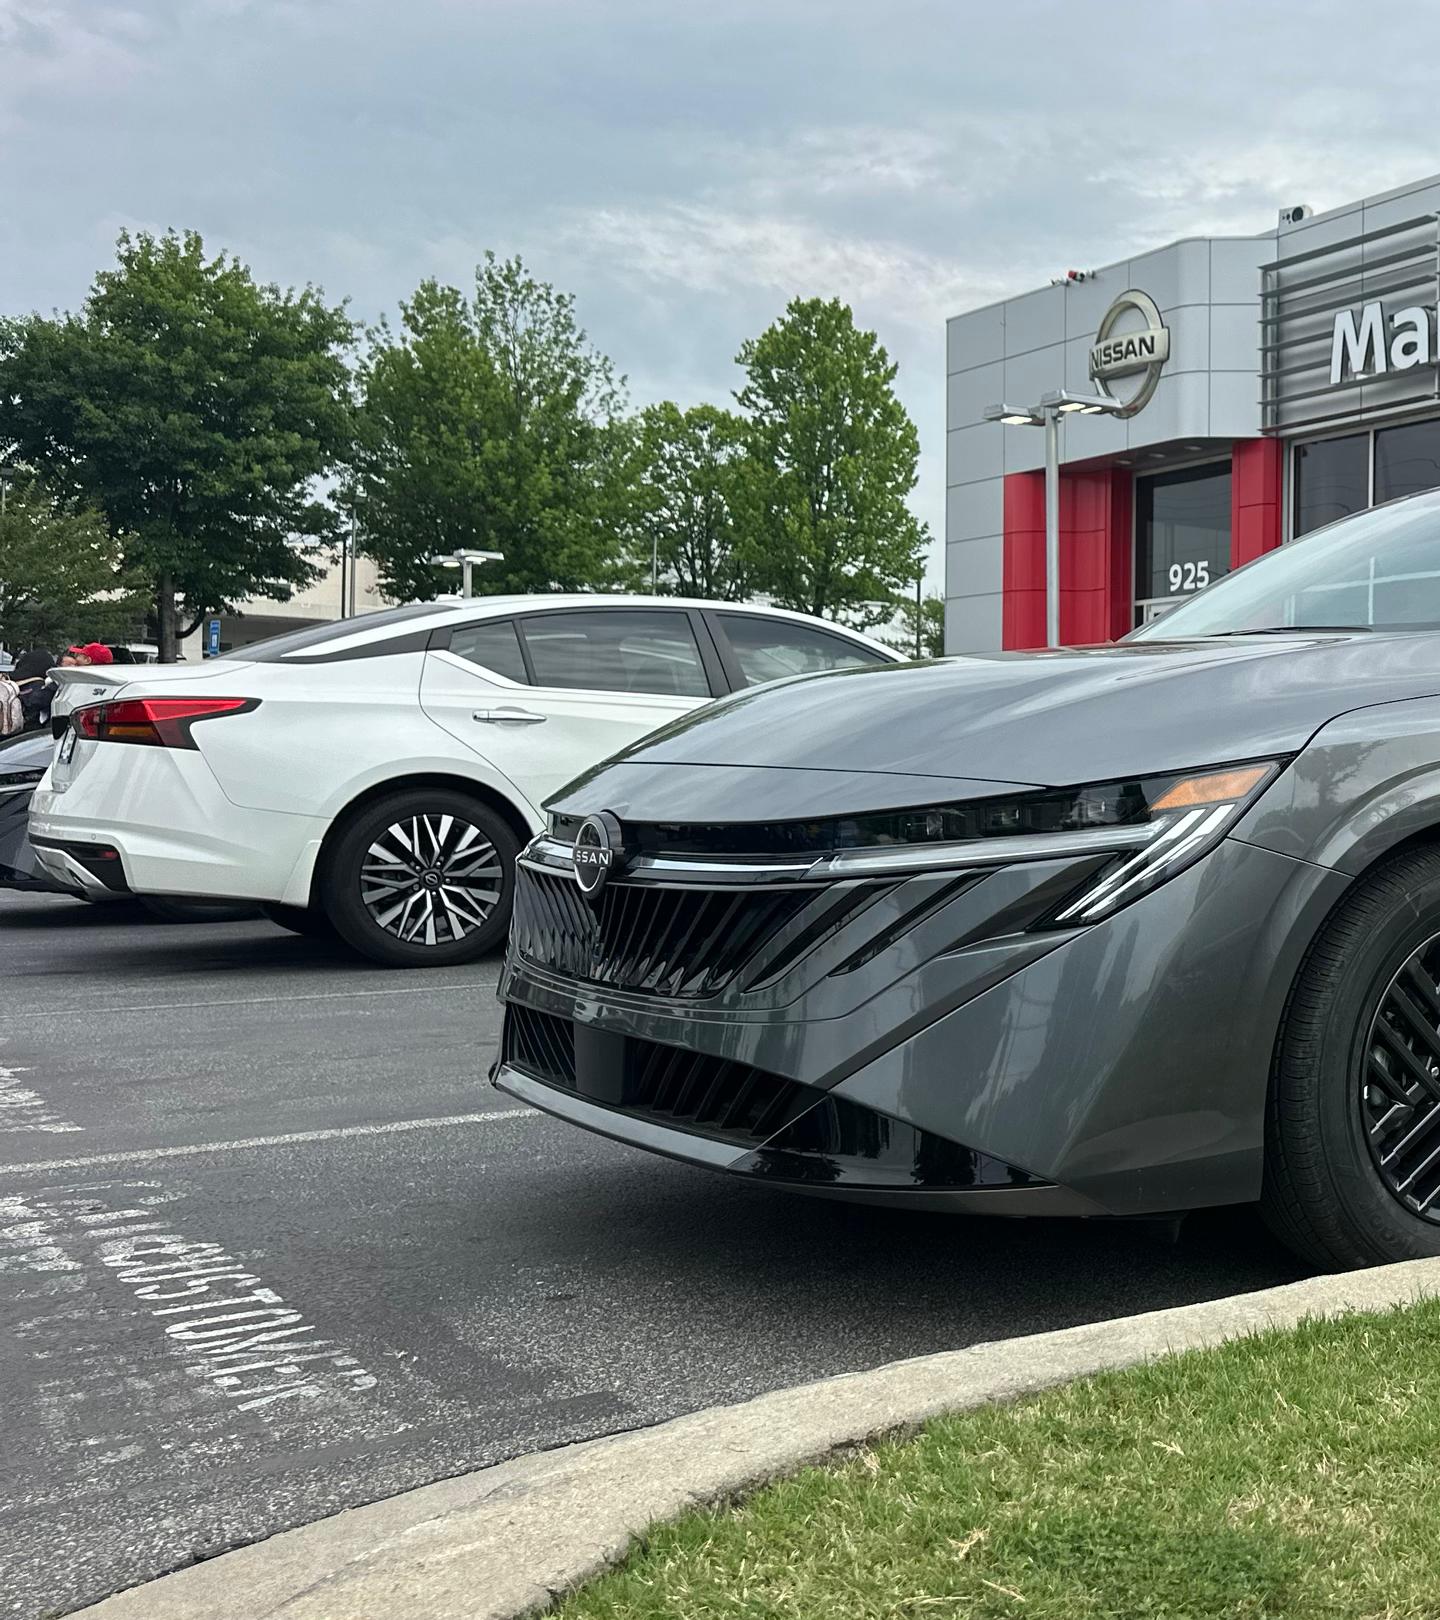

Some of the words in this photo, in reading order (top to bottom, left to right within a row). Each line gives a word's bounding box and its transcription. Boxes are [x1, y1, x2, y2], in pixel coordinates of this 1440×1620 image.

[1091, 335, 1155, 369] NISSAN
[1168, 560, 1210, 592] 925
[92, 687, 107, 696] SV
[576, 850, 609, 865] SSAN
